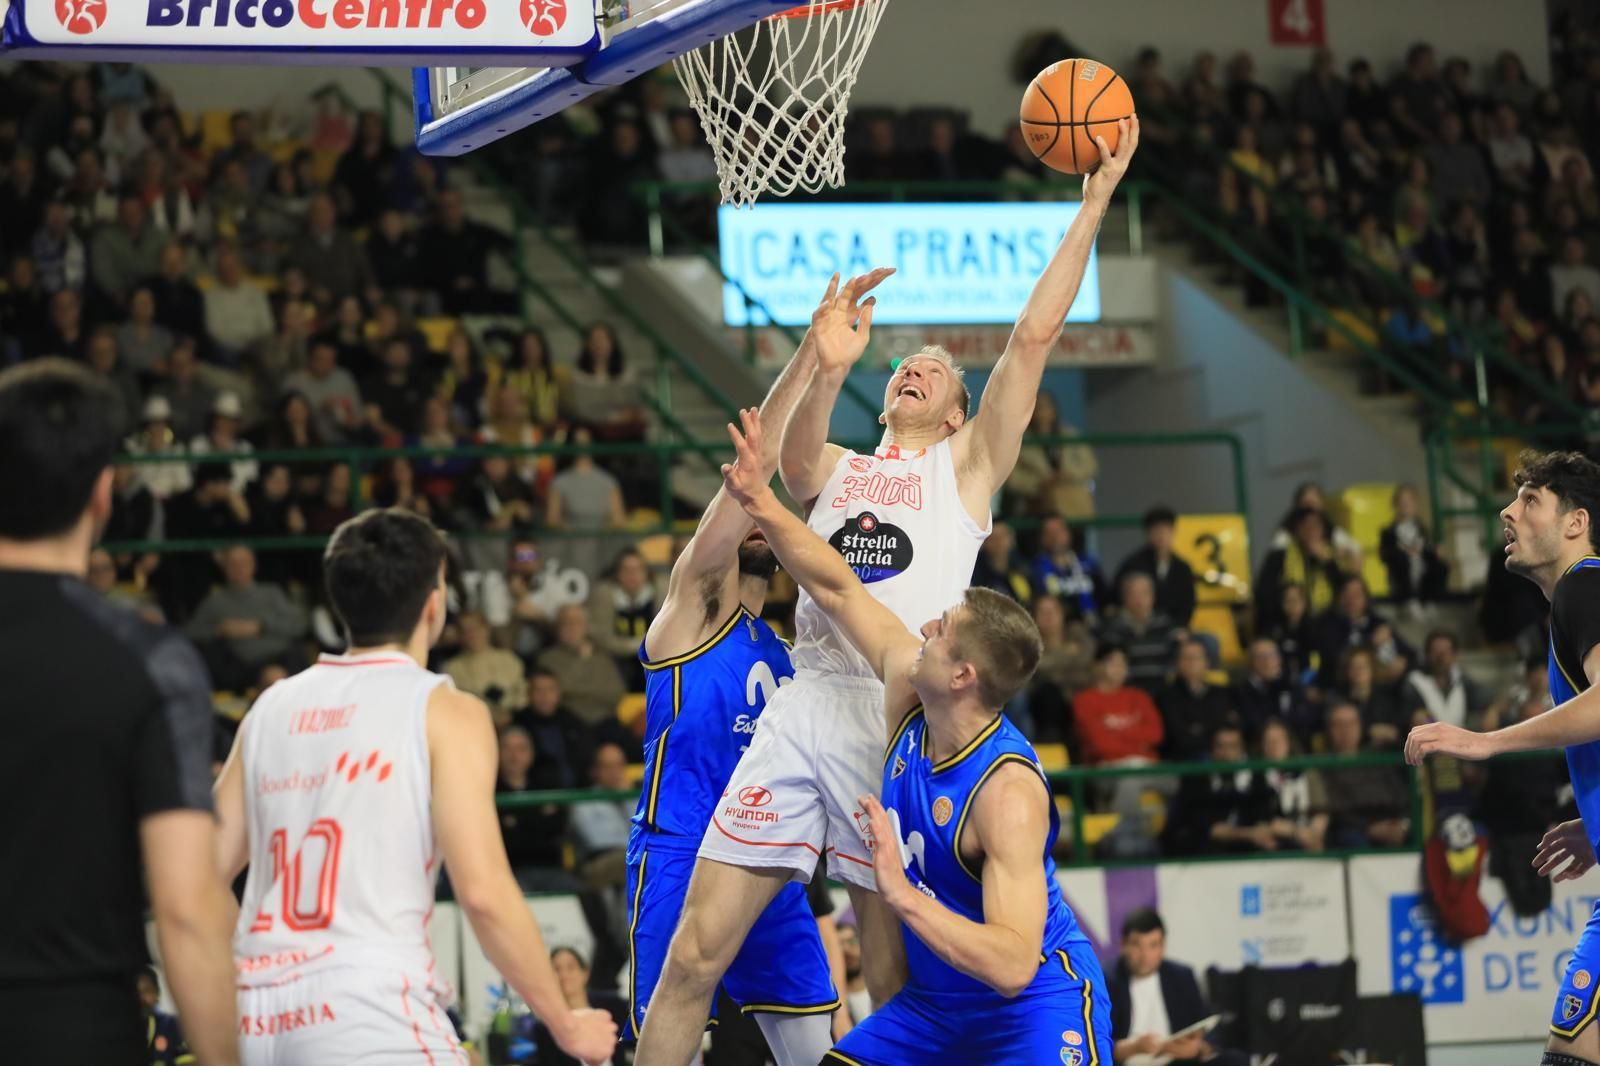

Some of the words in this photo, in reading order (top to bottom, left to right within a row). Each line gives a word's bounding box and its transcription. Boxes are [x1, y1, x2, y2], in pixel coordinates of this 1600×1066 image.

[146, 0, 487, 29] BricoCentro
[895, 228, 1068, 277] PRANS
[842, 533, 897, 550] strella
[842, 549, 893, 566] alicia
[725, 807, 779, 823] HYUNDAI
[249, 818, 343, 932] 10
